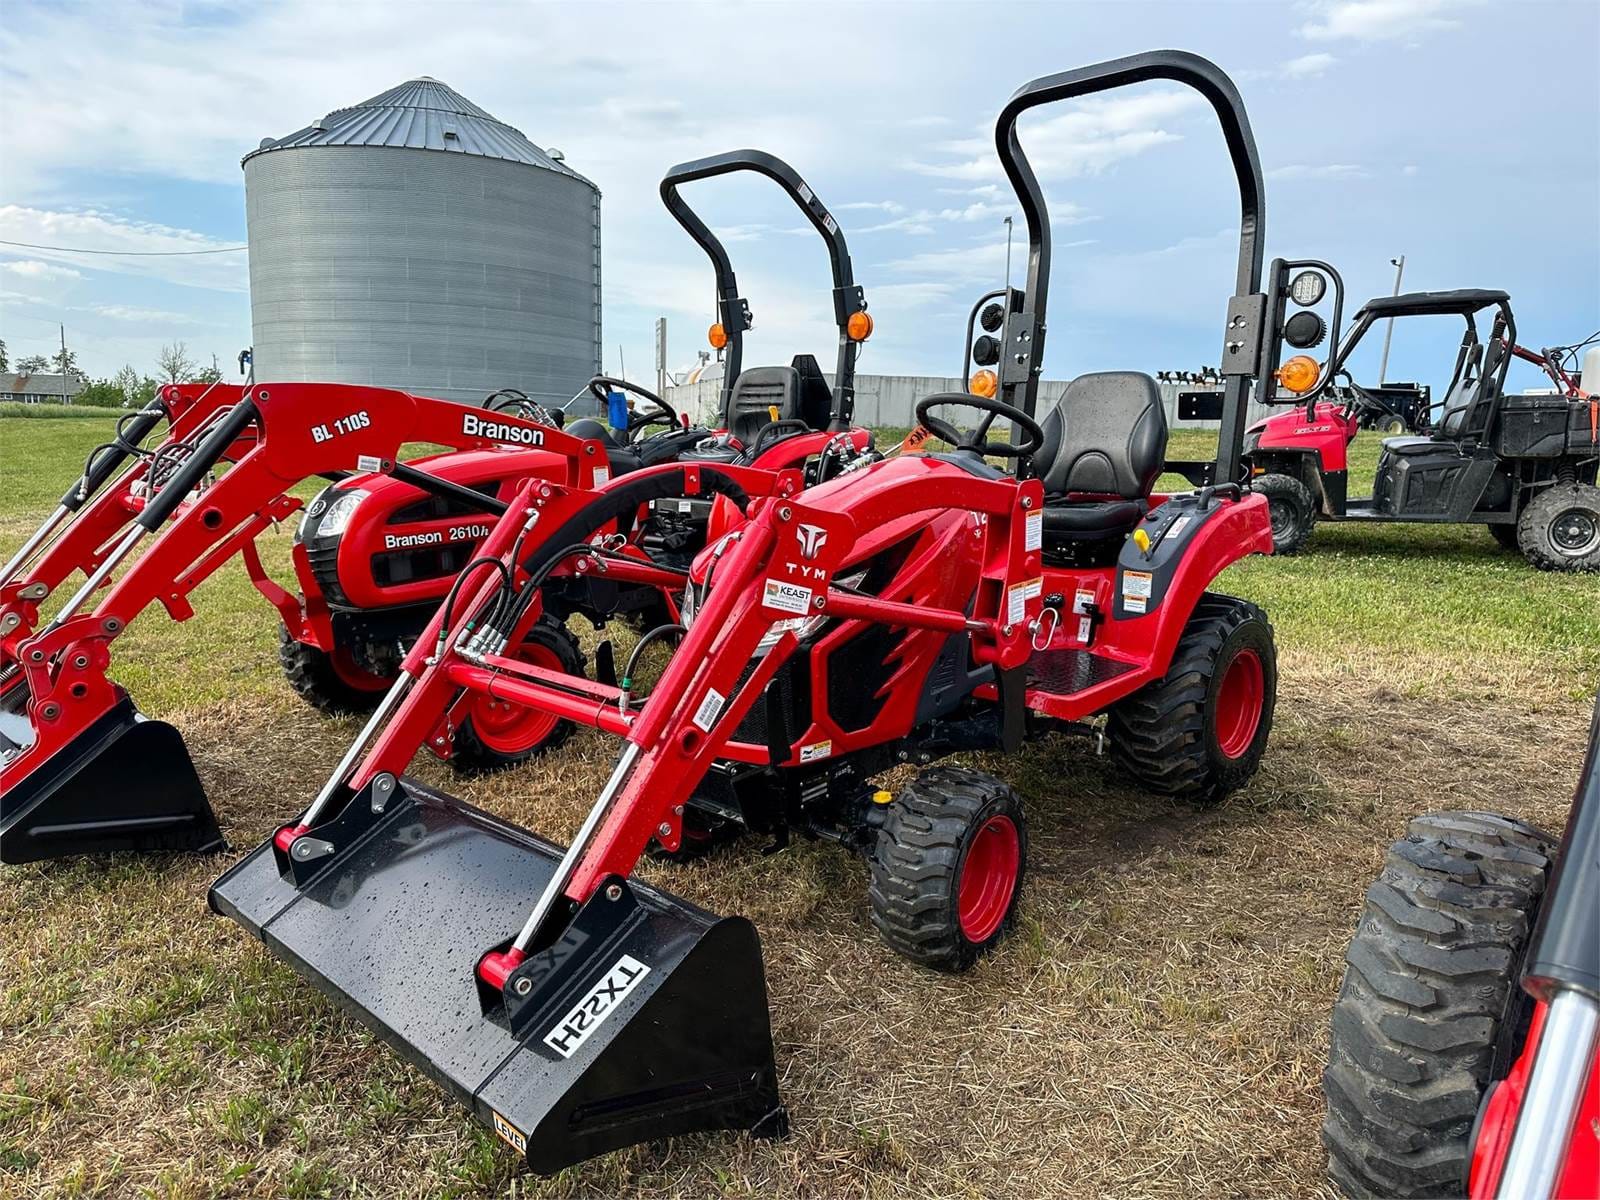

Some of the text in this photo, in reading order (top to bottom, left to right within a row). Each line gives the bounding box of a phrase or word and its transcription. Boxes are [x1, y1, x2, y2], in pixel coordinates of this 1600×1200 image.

[311, 410, 371, 443] BL 110S
[463, 413, 545, 446] Branson
[384, 524, 489, 549] Branson 2610h
[785, 562, 827, 581] TYM
[780, 585, 810, 600] KEAST
[549, 965, 644, 1053] TX22H
[495, 1118, 527, 1152] LEVEL
